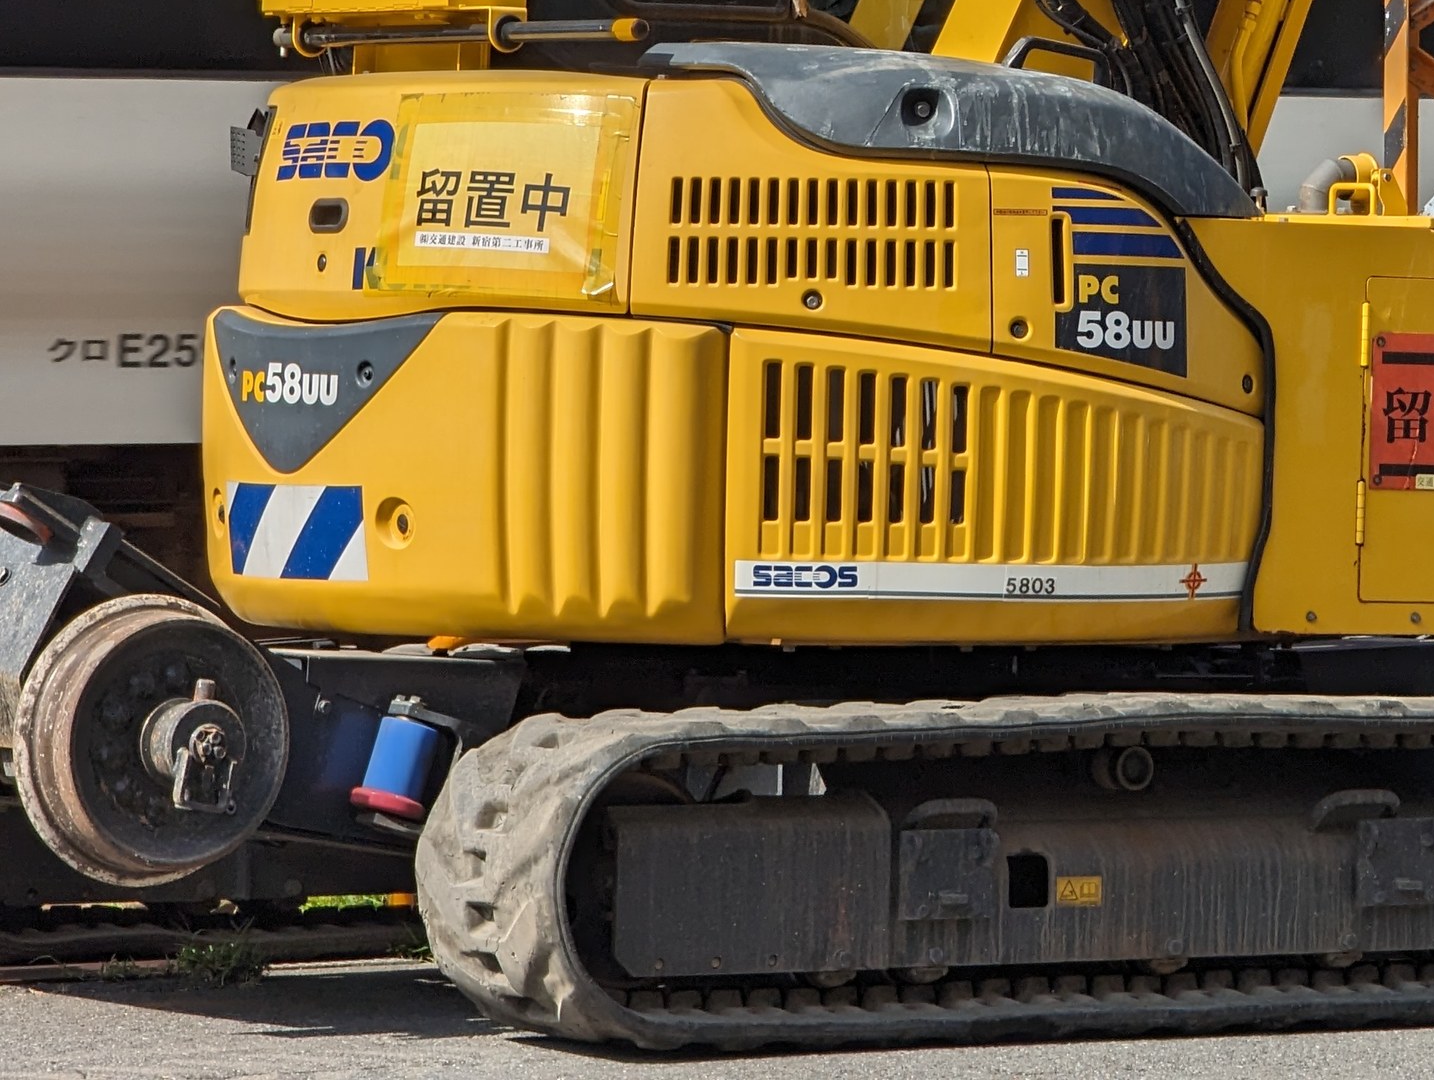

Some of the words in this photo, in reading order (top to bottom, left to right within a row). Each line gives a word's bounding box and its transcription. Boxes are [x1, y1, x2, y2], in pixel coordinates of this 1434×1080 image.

[416, 167, 571, 232] 留置中
[472, 235, 544, 251] 新宿第二工事所
[1078, 274, 1119, 305] PC
[1005, 576, 1056, 595] 5803
